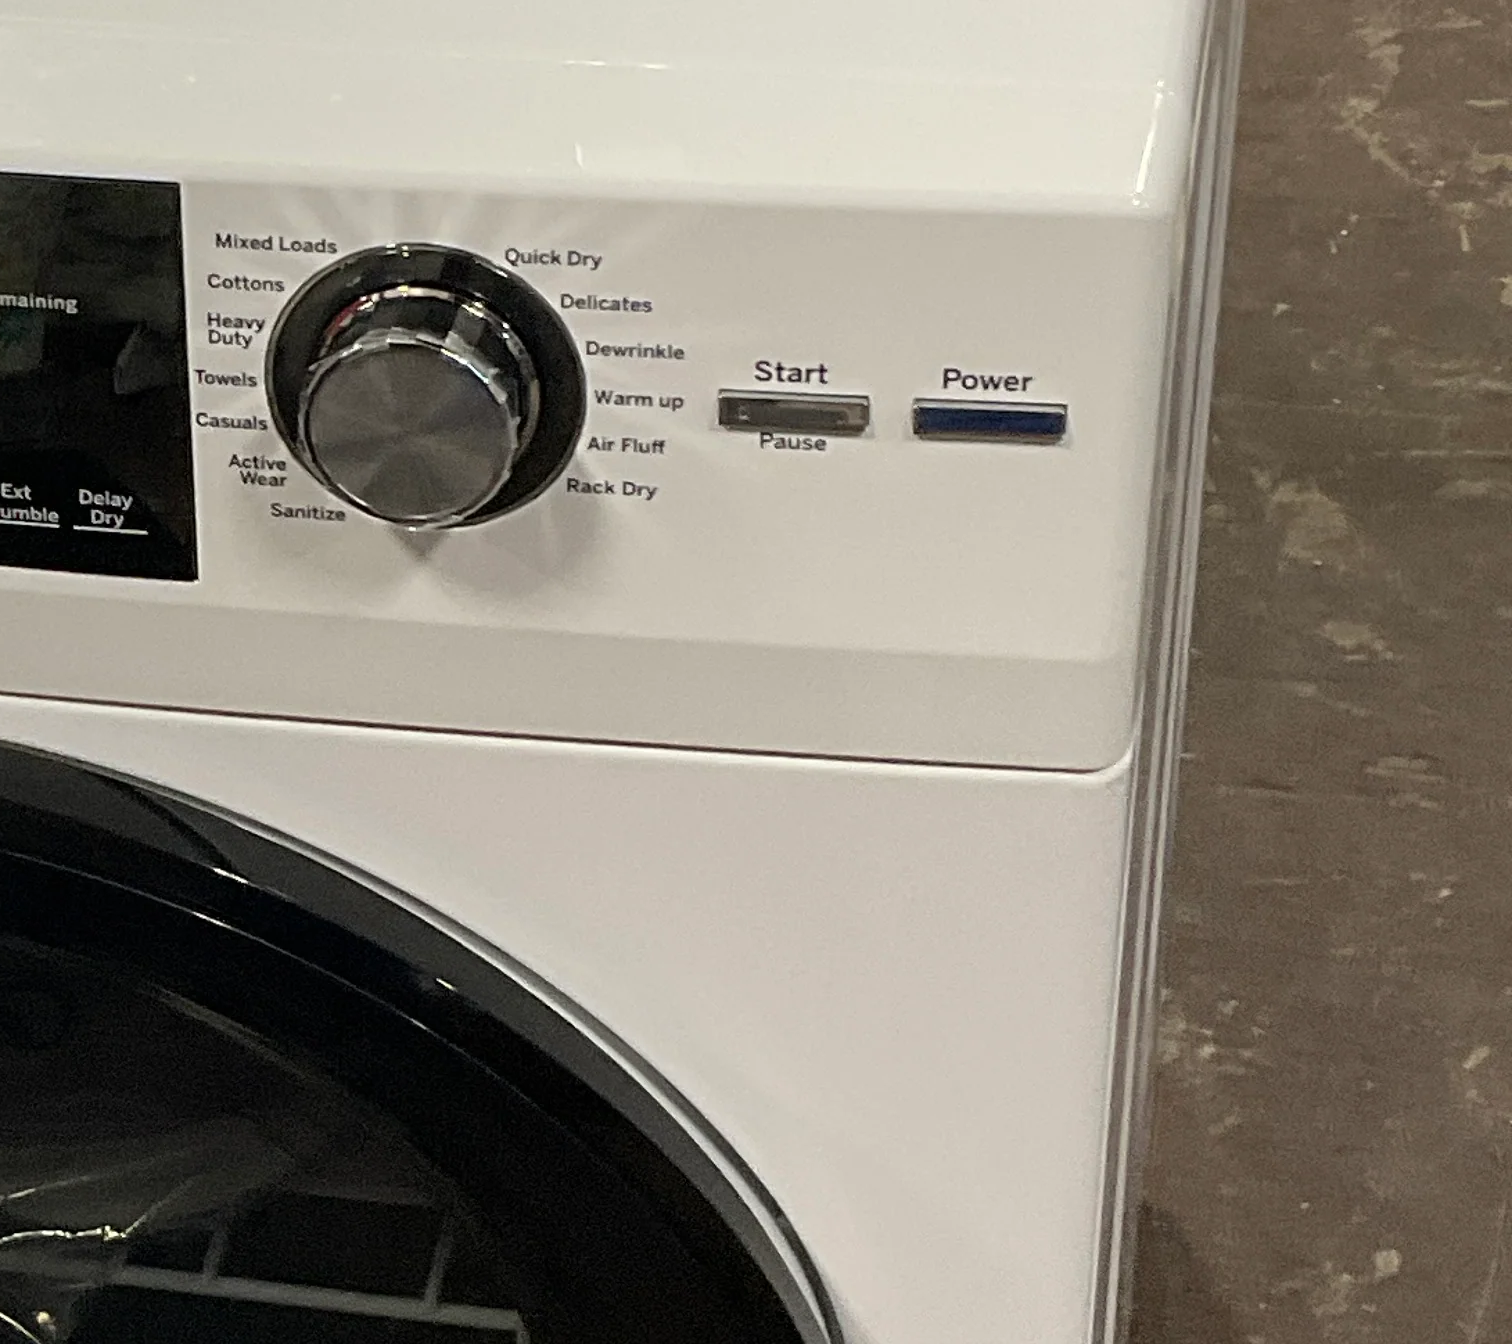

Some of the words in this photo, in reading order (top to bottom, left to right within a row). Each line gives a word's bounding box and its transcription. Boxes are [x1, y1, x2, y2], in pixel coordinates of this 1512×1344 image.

[216, 233, 273, 252] Mixed
[279, 236, 337, 253] Loads
[505, 247, 563, 268] Quick
[568, 250, 602, 270] Dry
[207, 274, 285, 293] Cottons
[560, 294, 652, 313] Delicates
[207, 313, 265, 333] Heavy
[208, 330, 253, 349] Duty
[586, 341, 684, 360] Dewrinkle
[195, 370, 257, 387] Towels
[754, 360, 828, 385] Start
[942, 368, 1034, 392] Power
[594, 390, 654, 409] Warm
[660, 397, 684, 411] up
[196, 413, 268, 431] Casuals
[588, 436, 617, 452] Air
[620, 438, 666, 455] Fluff
[760, 432, 827, 452] Pause
[229, 455, 287, 472] Active
[240, 471, 287, 488] Wear
[0, 482, 31, 501] Ext
[567, 478, 614, 495] Rack
[620, 480, 657, 501] Dry
[78, 488, 133, 511] Delay
[90, 508, 124, 529] Dry
[271, 503, 346, 522] Sanitize
